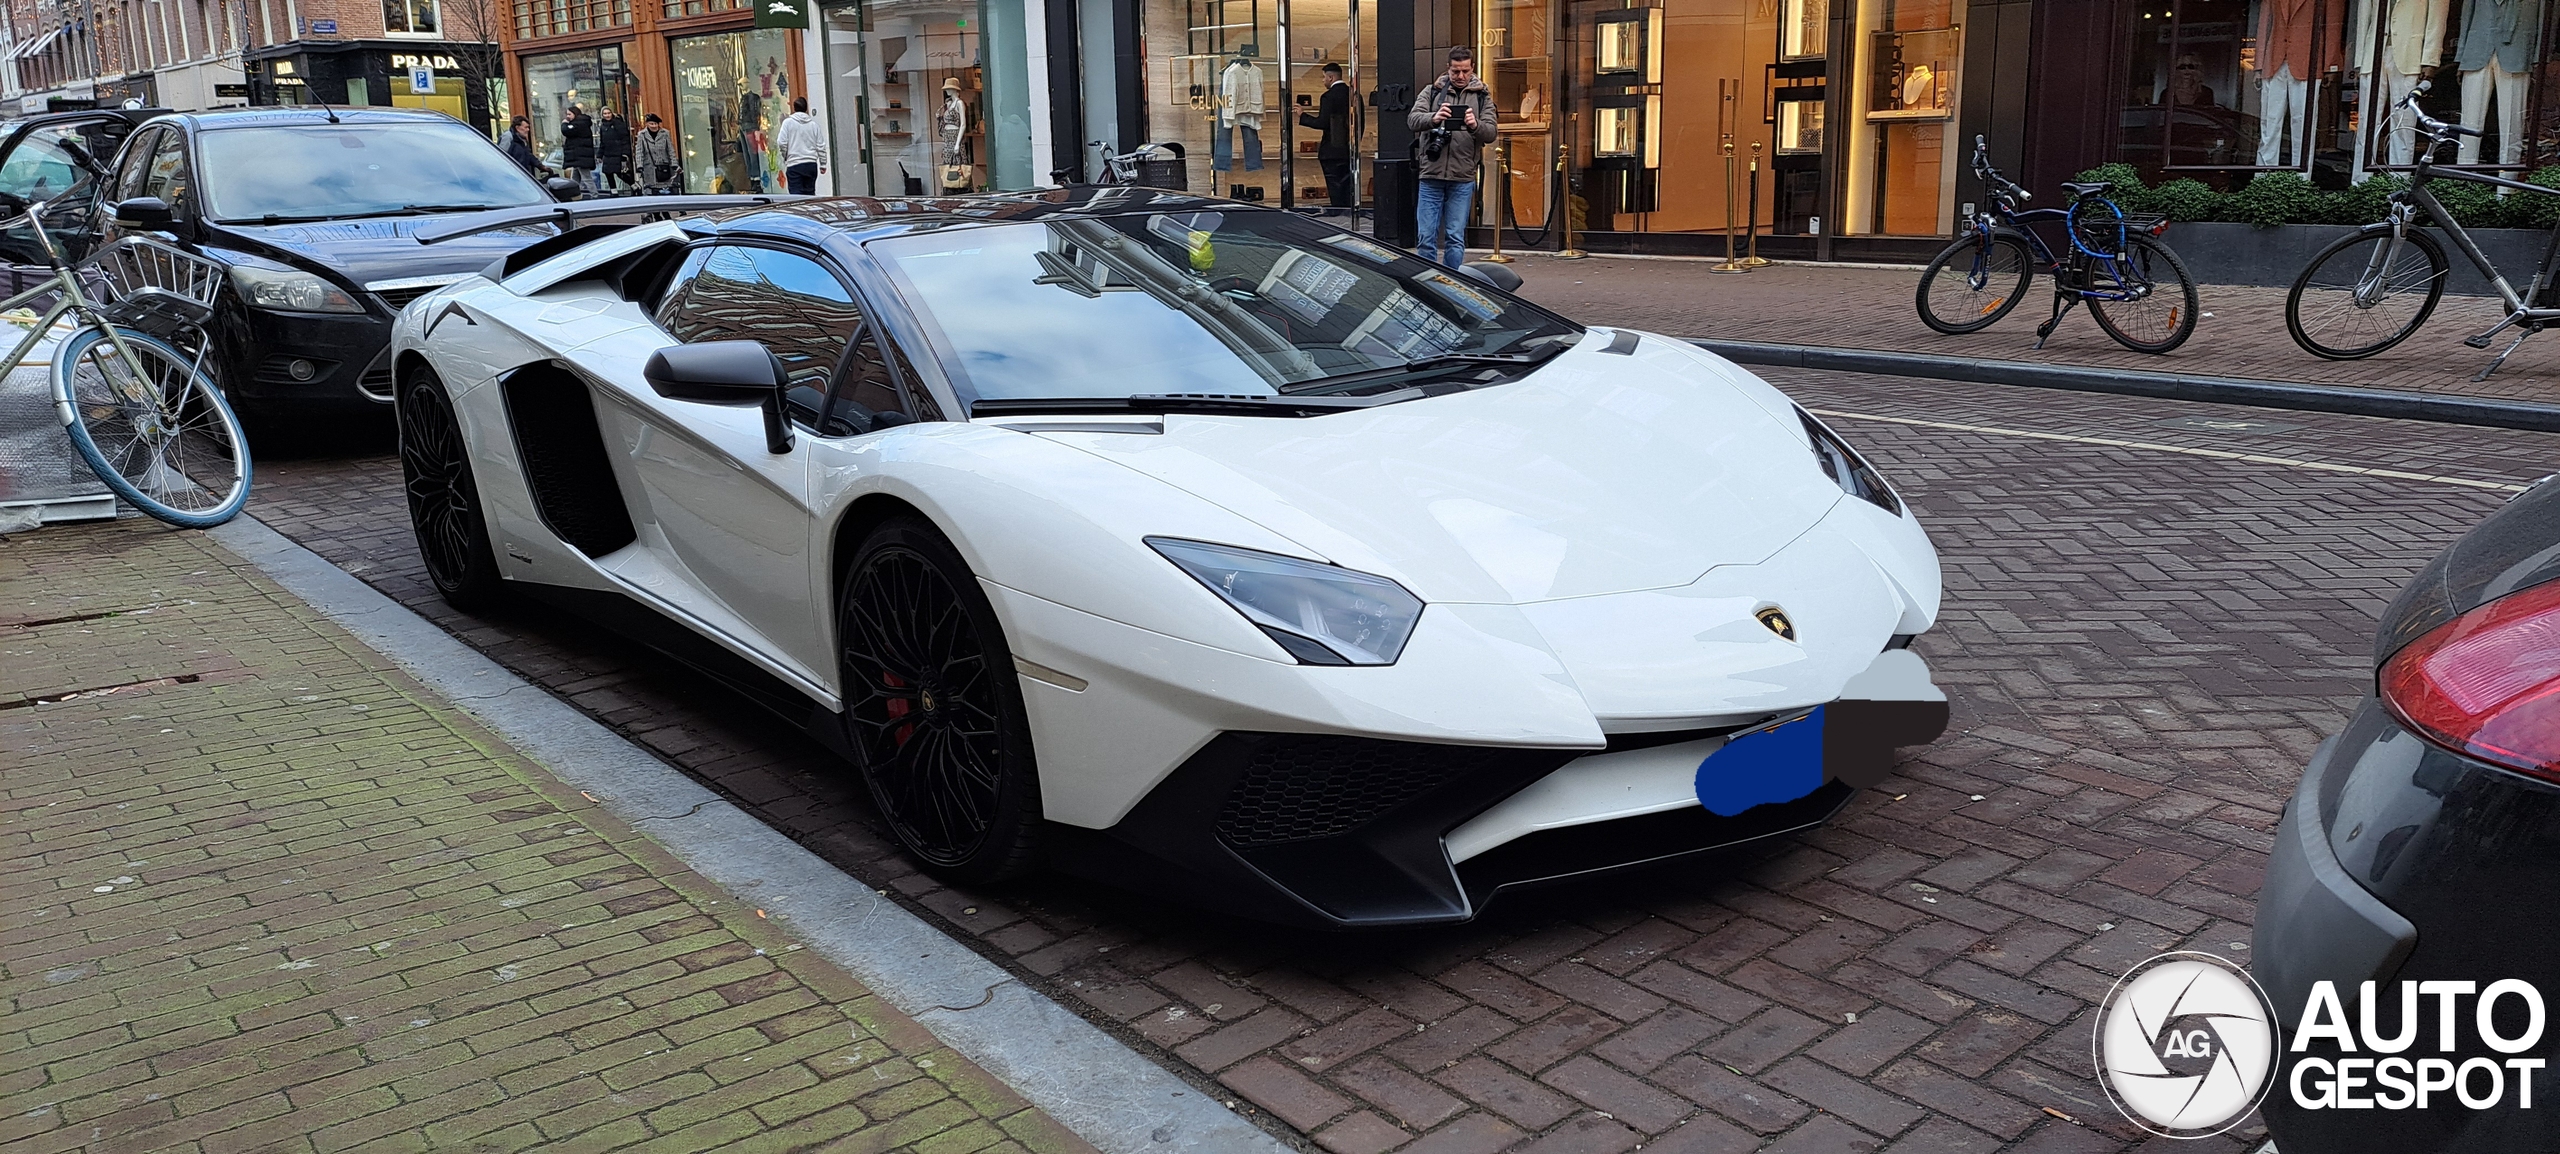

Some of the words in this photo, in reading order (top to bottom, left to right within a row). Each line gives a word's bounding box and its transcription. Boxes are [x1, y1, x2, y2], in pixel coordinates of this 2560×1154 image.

[391, 54, 460, 69] PRADA
[418, 72, 425, 81] P
[1190, 94, 1233, 110] CELINE
